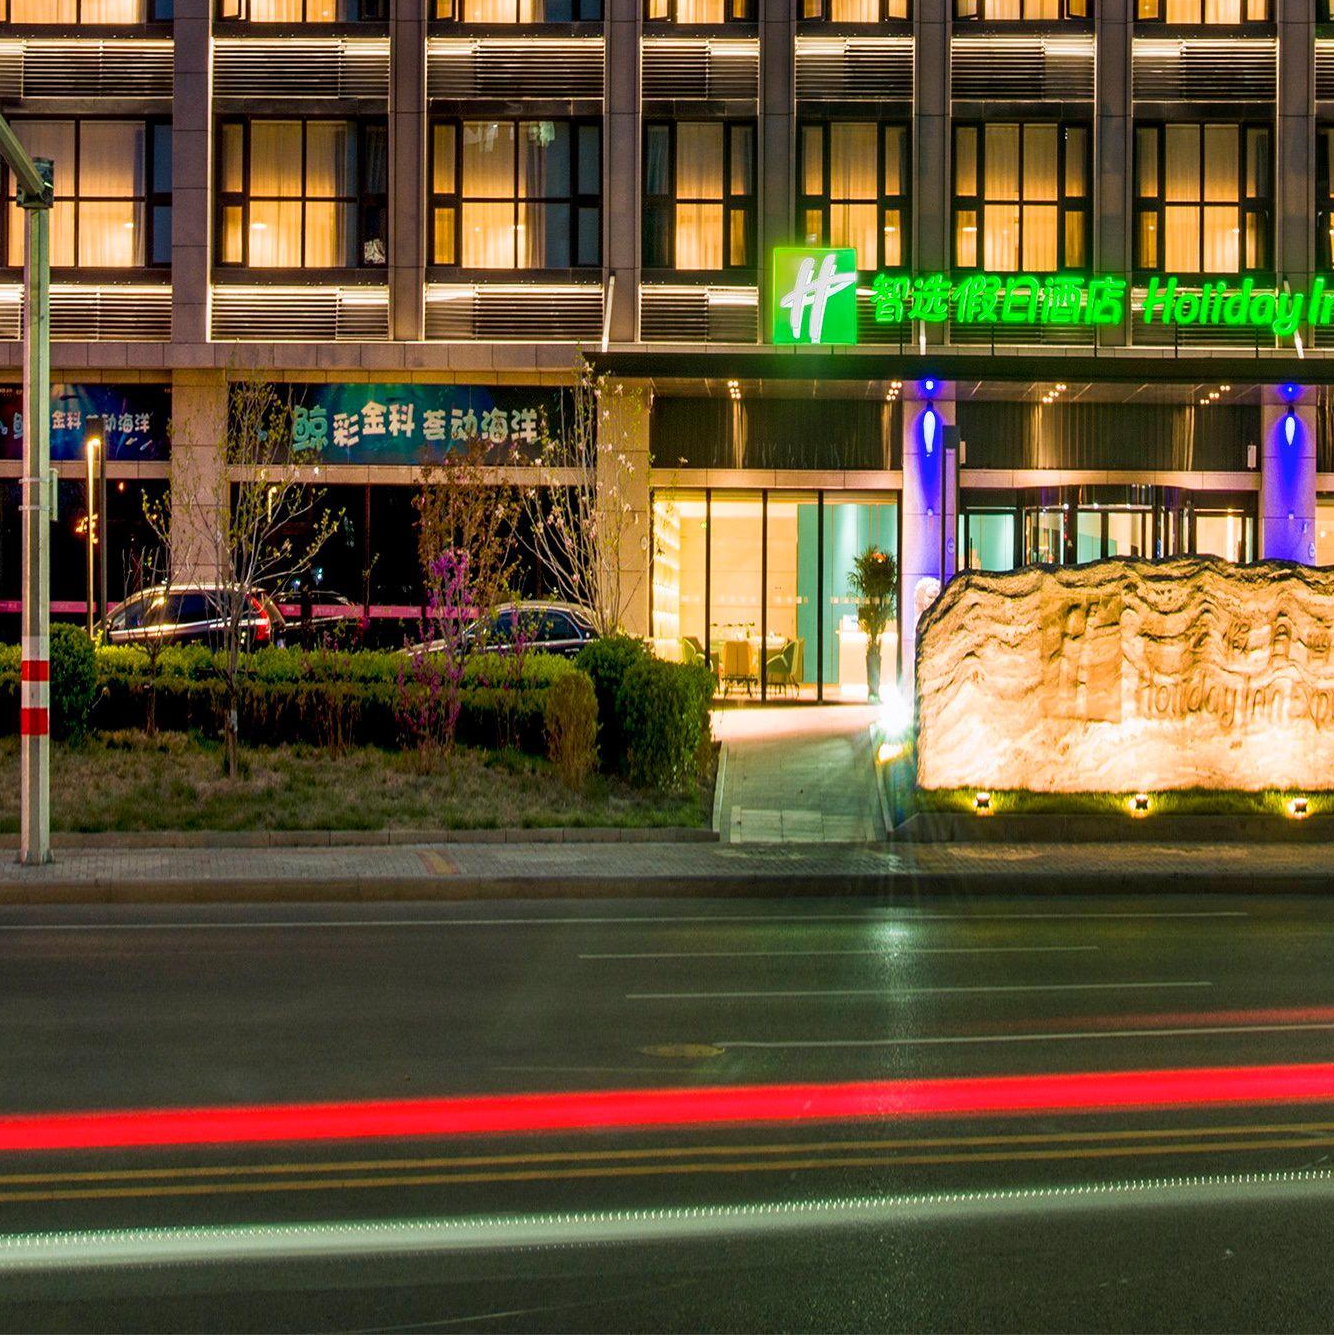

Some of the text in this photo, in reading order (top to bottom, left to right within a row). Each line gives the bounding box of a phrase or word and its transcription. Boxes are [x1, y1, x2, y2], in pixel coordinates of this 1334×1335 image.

[870, 273, 1126, 325] 智选假日酒店
[1142, 277, 1304, 336] Holiday
